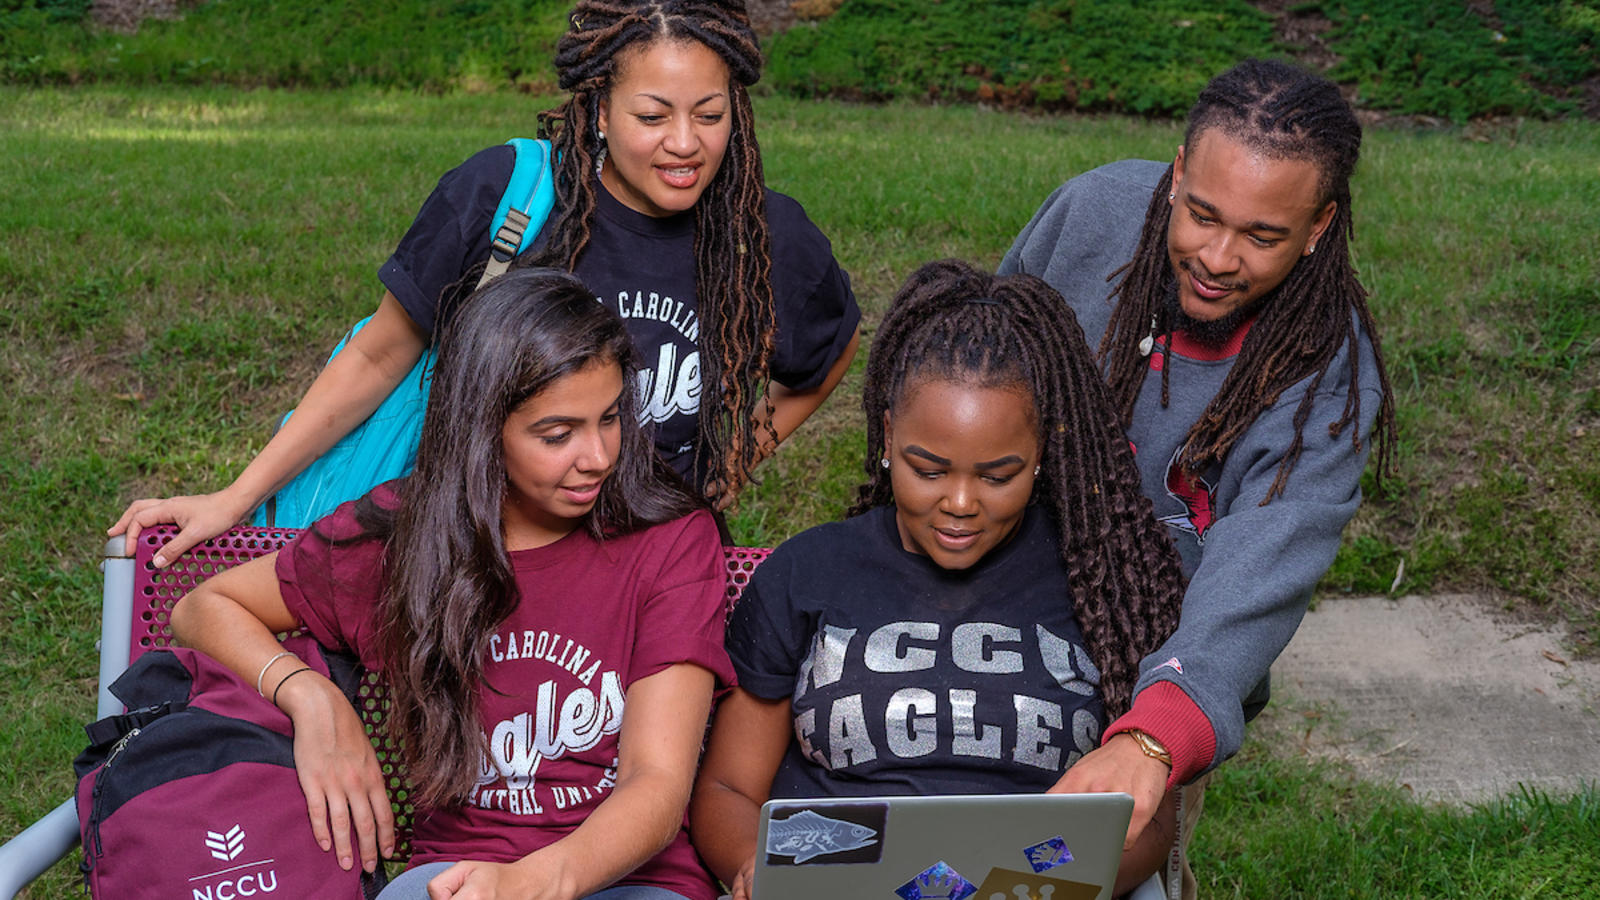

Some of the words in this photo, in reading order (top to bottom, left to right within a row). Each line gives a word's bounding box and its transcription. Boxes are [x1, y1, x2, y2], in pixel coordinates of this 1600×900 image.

[618, 290, 699, 345] CAROLIN
[490, 630, 602, 685] CAROLINA
[192, 870, 278, 900] NCCU
